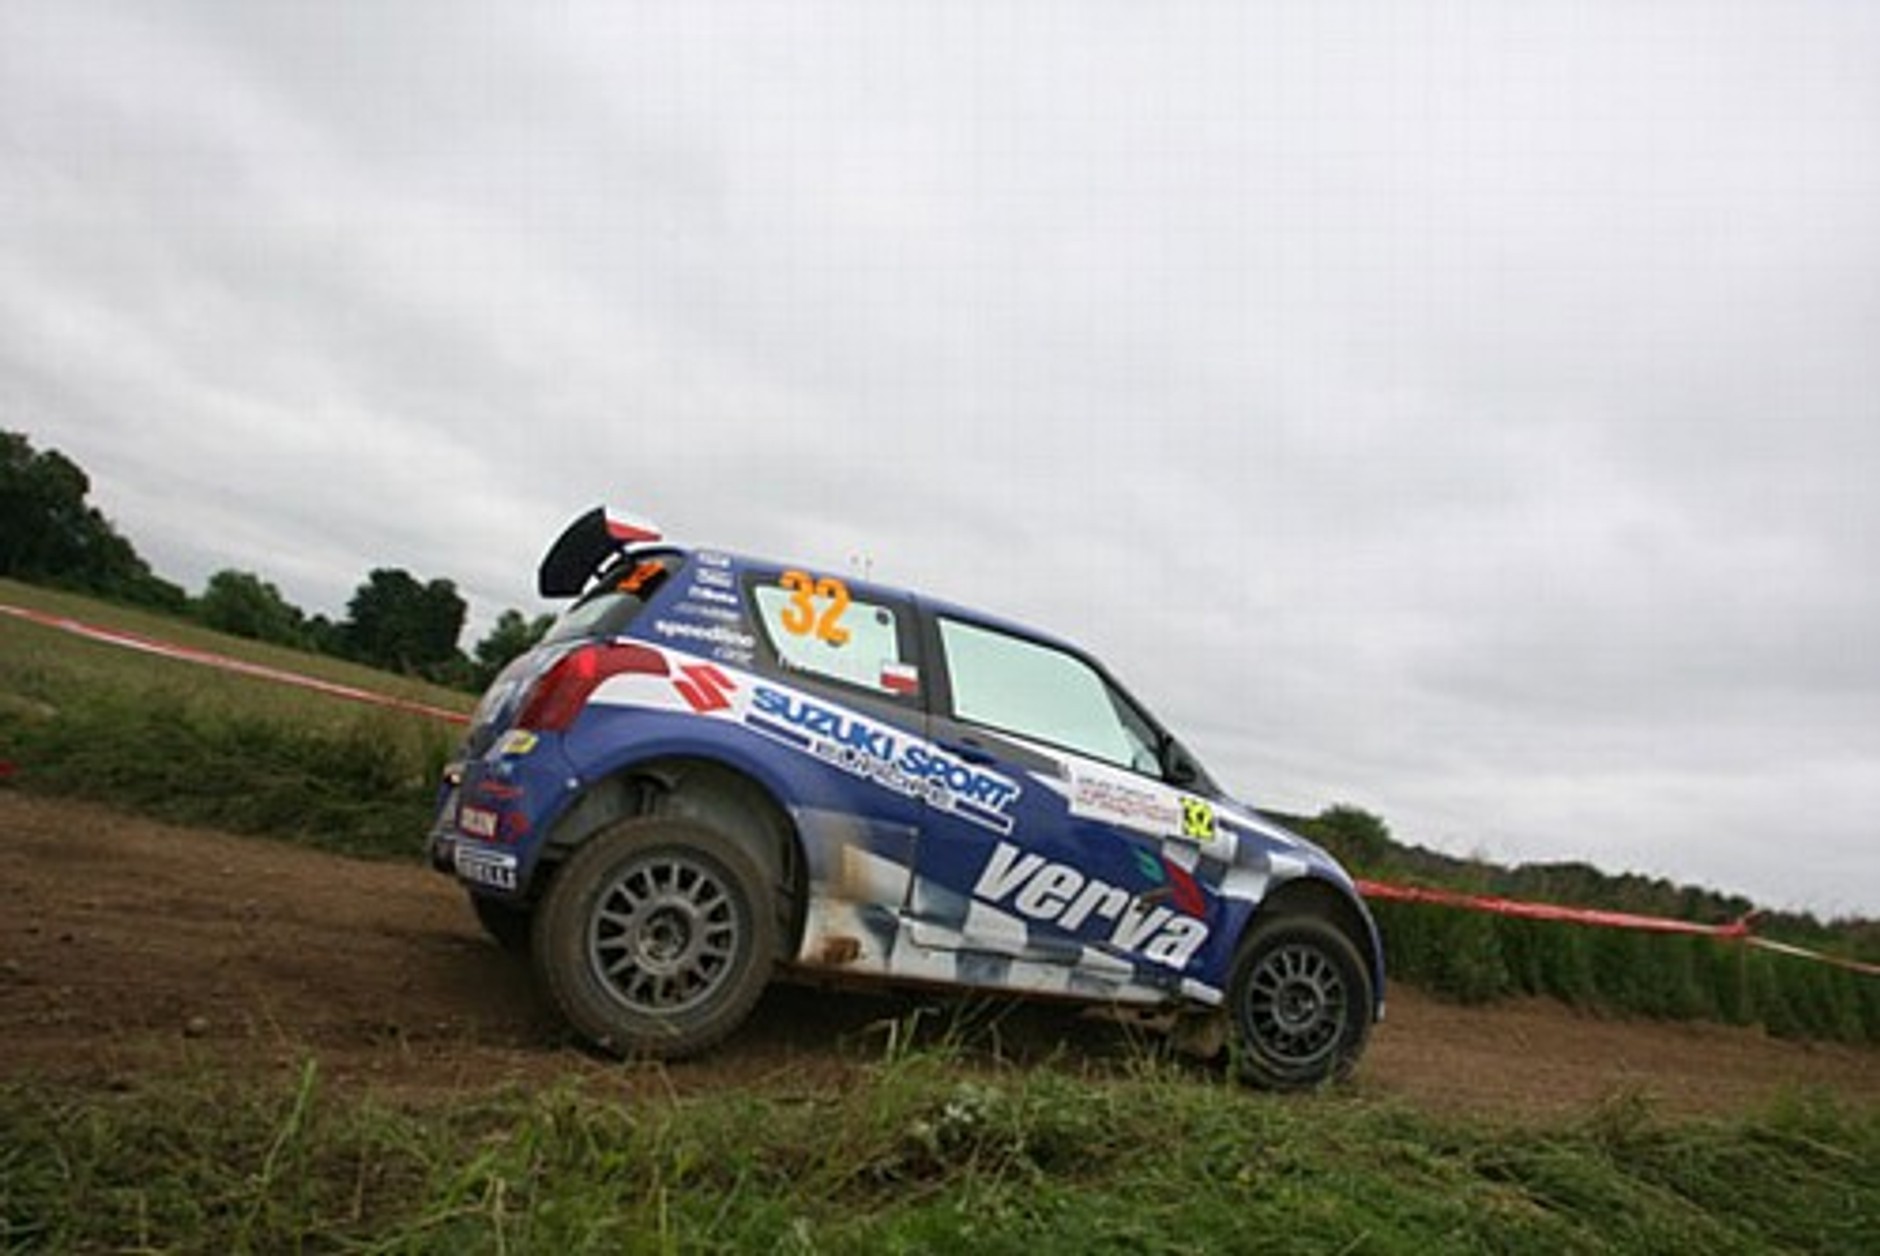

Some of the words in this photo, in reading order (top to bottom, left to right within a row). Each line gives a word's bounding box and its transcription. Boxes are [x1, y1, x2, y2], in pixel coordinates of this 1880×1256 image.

[778, 567, 852, 645] 32
[752, 687, 895, 761] SUZUKI
[899, 746, 1018, 806] SPORT
[1180, 797, 1215, 840] 32
[973, 841, 1209, 971] verva
